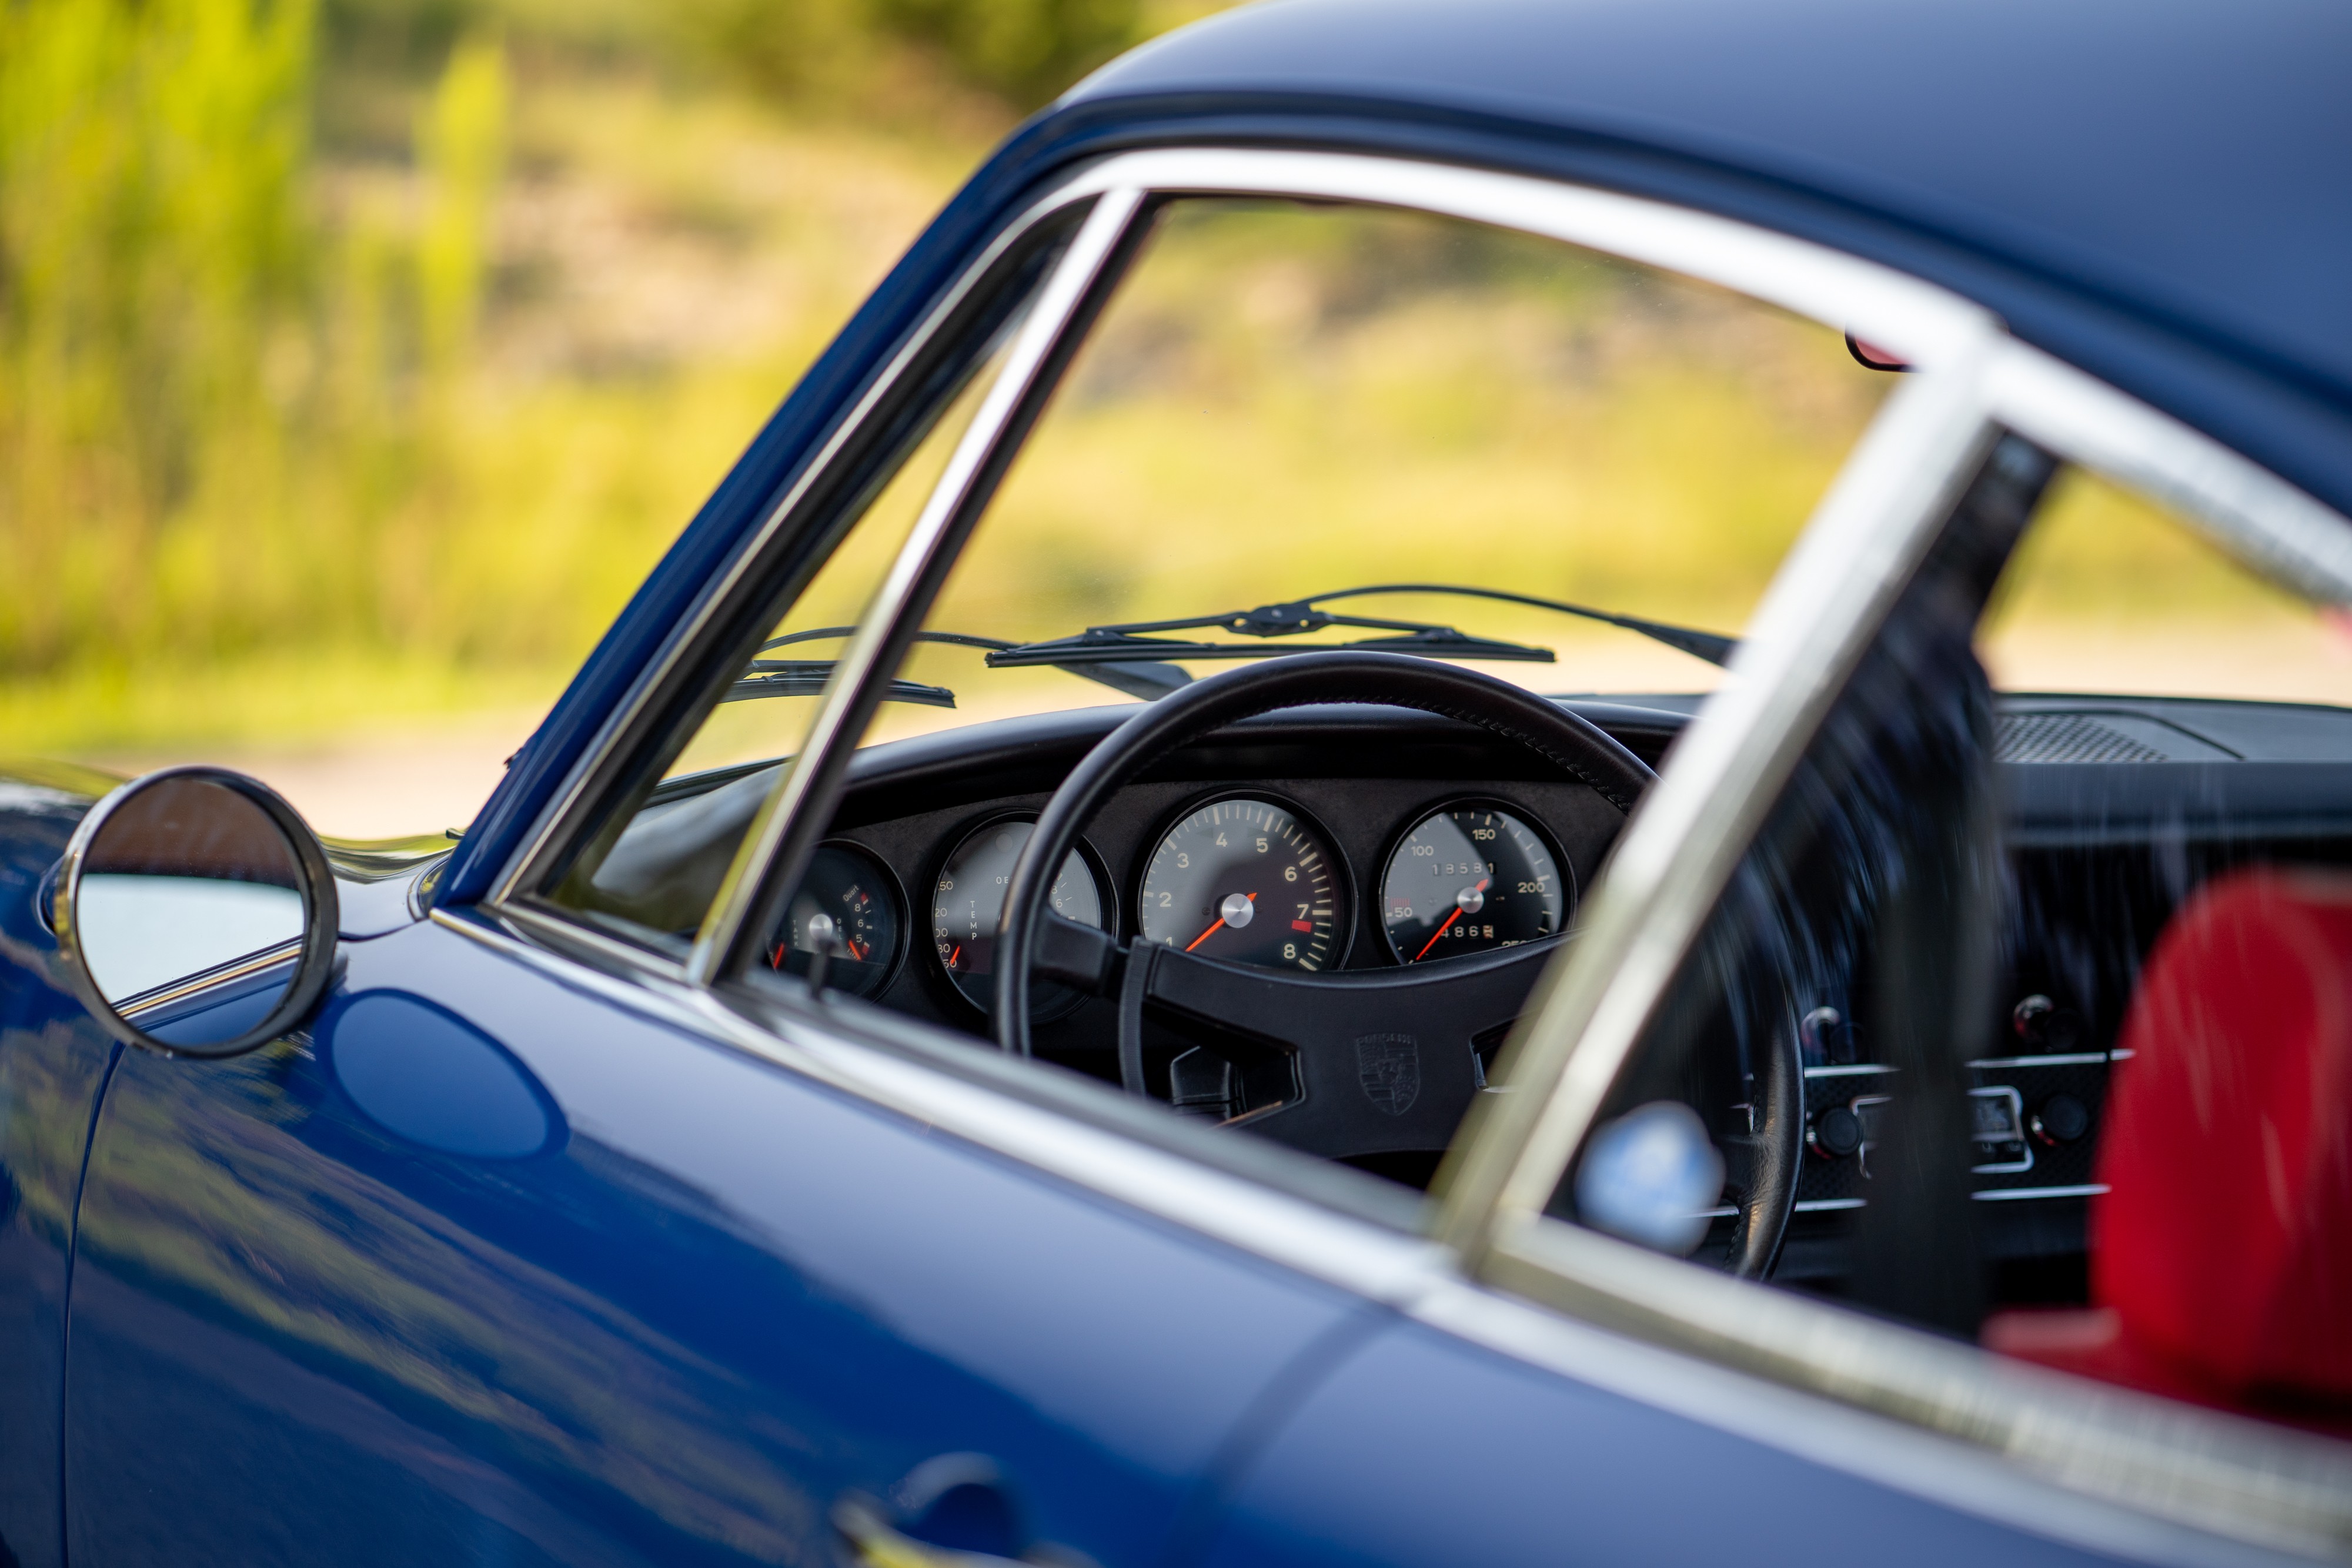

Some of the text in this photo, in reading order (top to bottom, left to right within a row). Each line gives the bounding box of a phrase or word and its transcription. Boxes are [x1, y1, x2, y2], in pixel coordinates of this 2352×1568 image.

[1216, 833, 1227, 847] 4
[1472, 829, 1496, 840] 150
[1257, 838, 1268, 852] 5
[1411, 845, 1434, 856] 100
[1177, 853, 1189, 868] 3
[1285, 867, 1297, 881] 6
[843, 884, 859, 902] Quart
[1518, 882, 1545, 893] 200
[1056, 899, 1063, 908] 6
[1160, 892, 1171, 907] 2
[854, 904, 861, 912] 8
[1297, 904, 1309, 919] 7
[1395, 907, 1412, 918] 50
[858, 919, 864, 928] 6
[856, 934, 863, 943] 5
[1166, 937, 1172, 947] 1
[1284, 944, 1296, 959] 8
